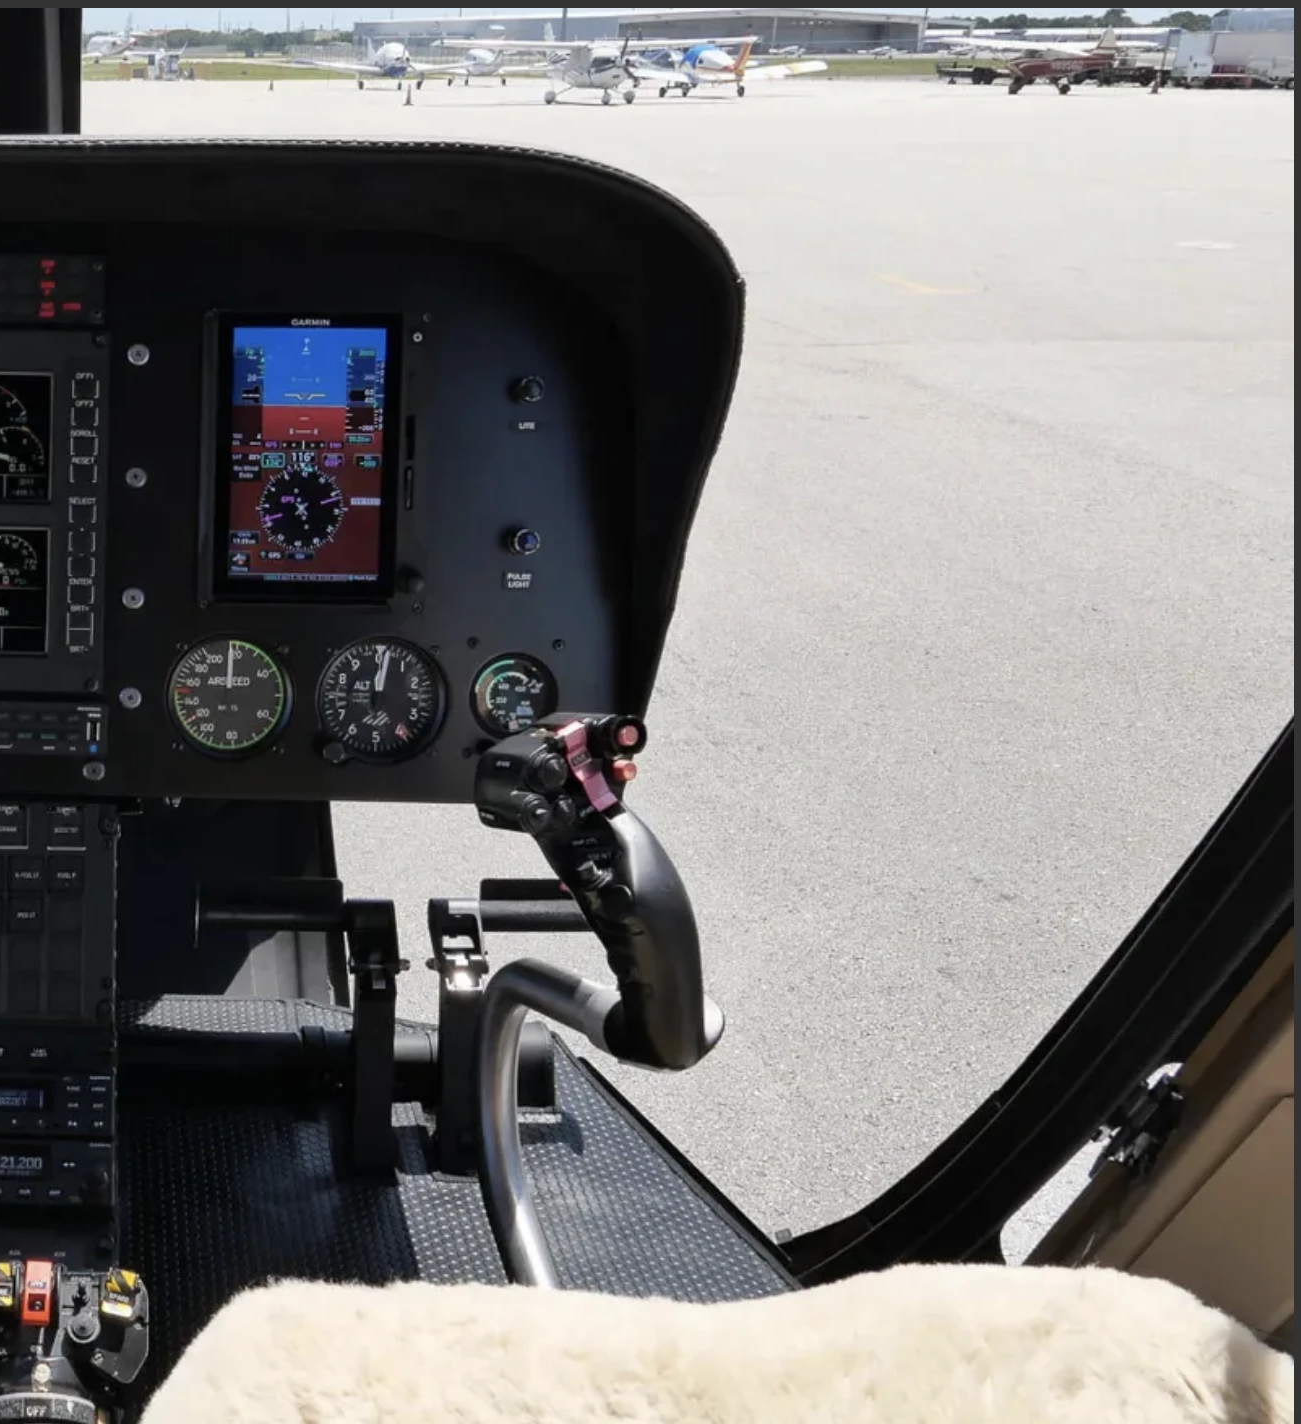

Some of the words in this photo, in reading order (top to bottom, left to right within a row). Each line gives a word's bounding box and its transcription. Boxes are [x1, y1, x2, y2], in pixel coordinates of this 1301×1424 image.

[291, 318, 330, 326] GARMIN
[506, 572, 532, 581] PULSE
[508, 580, 530, 589] LIGHT
[206, 654, 224, 665] 200
[194, 663, 209, 674] 180
[351, 659, 360, 672] 9
[207, 676, 251, 687] AIRSEED
[339, 673, 347, 685] 8
[411, 677, 419, 690] 2
[354, 681, 372, 691] ALT
[256, 709, 270, 719] 60
[338, 708, 347, 721] 7
[409, 708, 419, 721] 3
[199, 723, 215, 733] 100
[347, 723, 357, 736] 6
[225, 731, 239, 741] 80
[371, 731, 381, 744] 5
[26, 1405, 48, 1418] OFF
